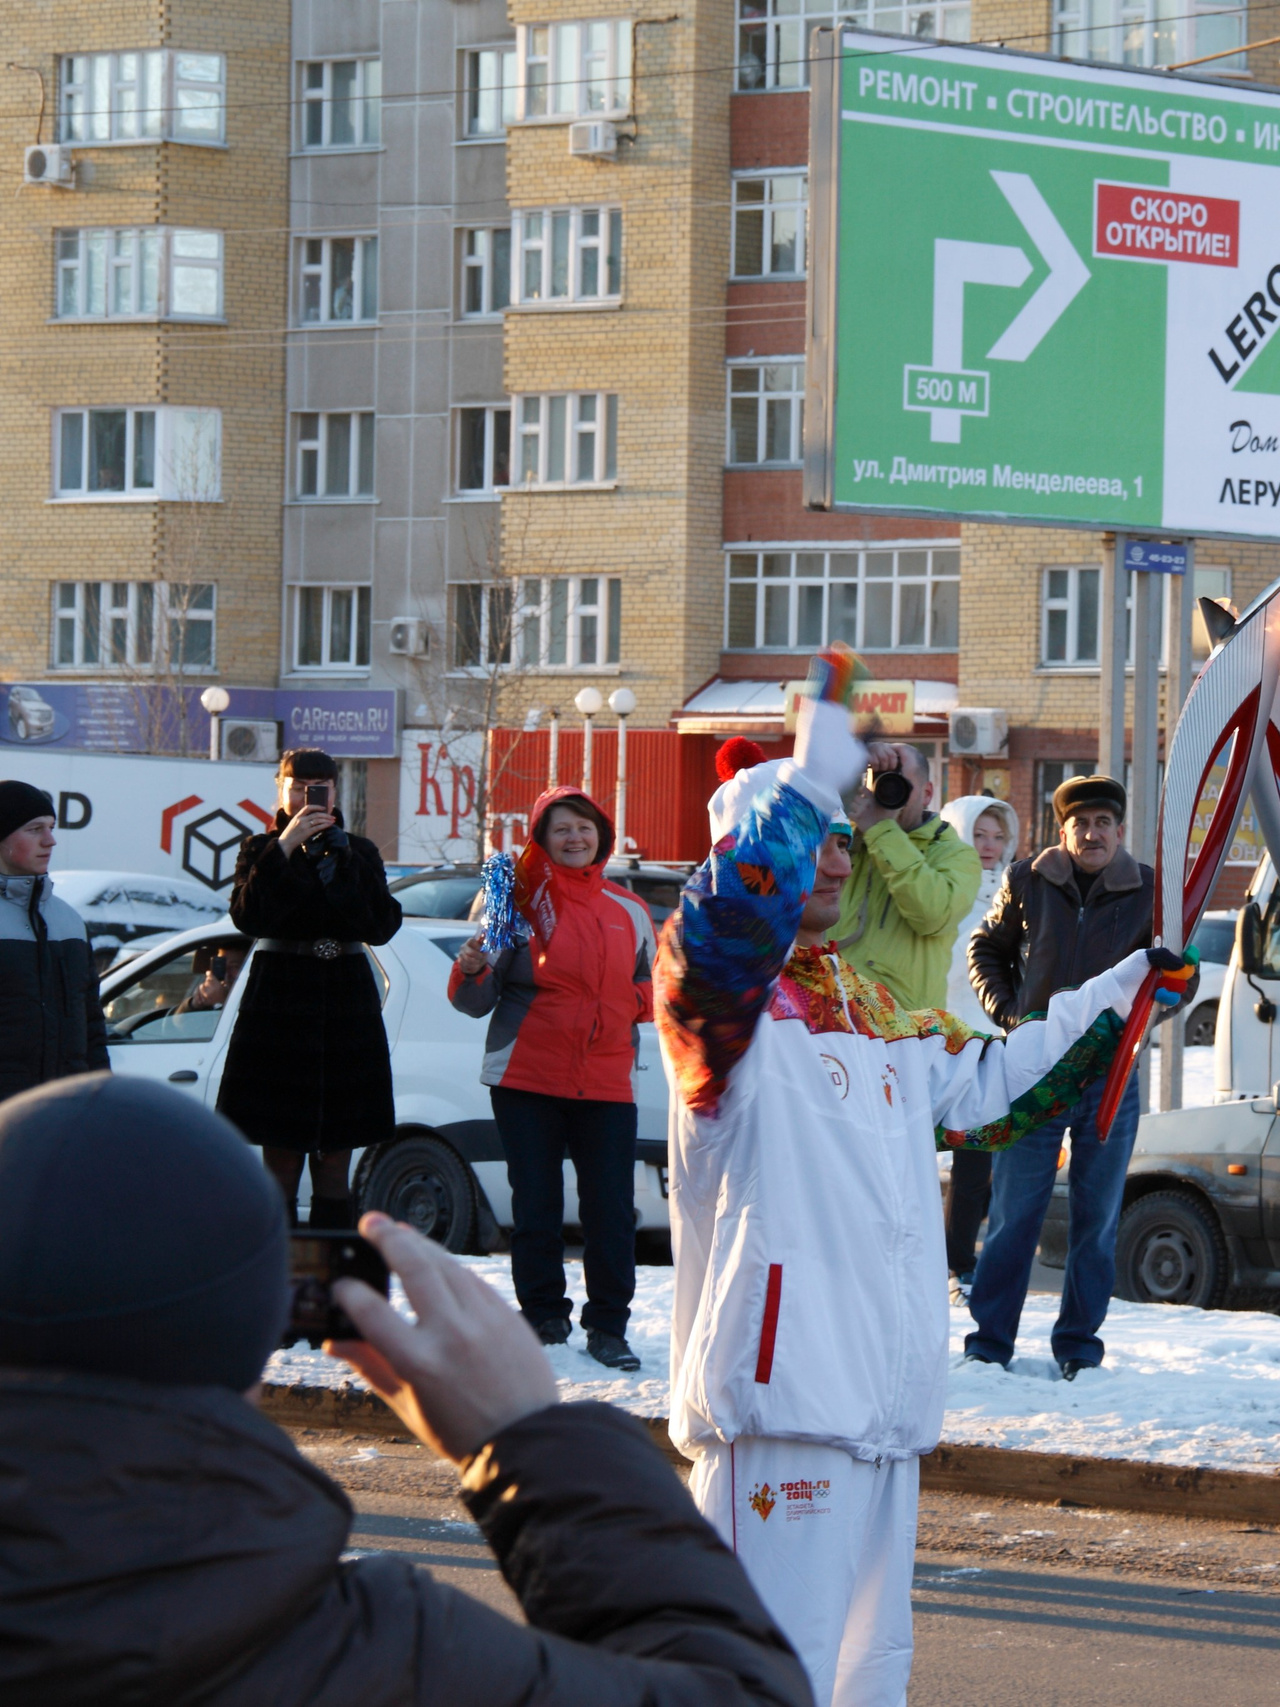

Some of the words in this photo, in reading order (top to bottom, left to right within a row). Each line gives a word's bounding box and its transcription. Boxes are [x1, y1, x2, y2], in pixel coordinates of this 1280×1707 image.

[859, 67, 978, 111] РЕМОНТ
[1007, 88, 1227, 144] СТРОИТЕЛЬСТВО
[1130, 196, 1207, 227] СКОРО
[1105, 222, 1230, 258] ОТКРЫТИЕ!
[916, 377, 952, 402] 500
[958, 381, 977, 404] М
[1229, 419, 1278, 453] Дом
[853, 459, 884, 482] ул.
[889, 456, 986, 489] Дмитрия
[993, 464, 1128, 501] Менделеева,
[1133, 476, 1143, 498] 1
[780, 1479, 830, 1492] sochi.ru
[786, 1490, 812, 1501] 2014
